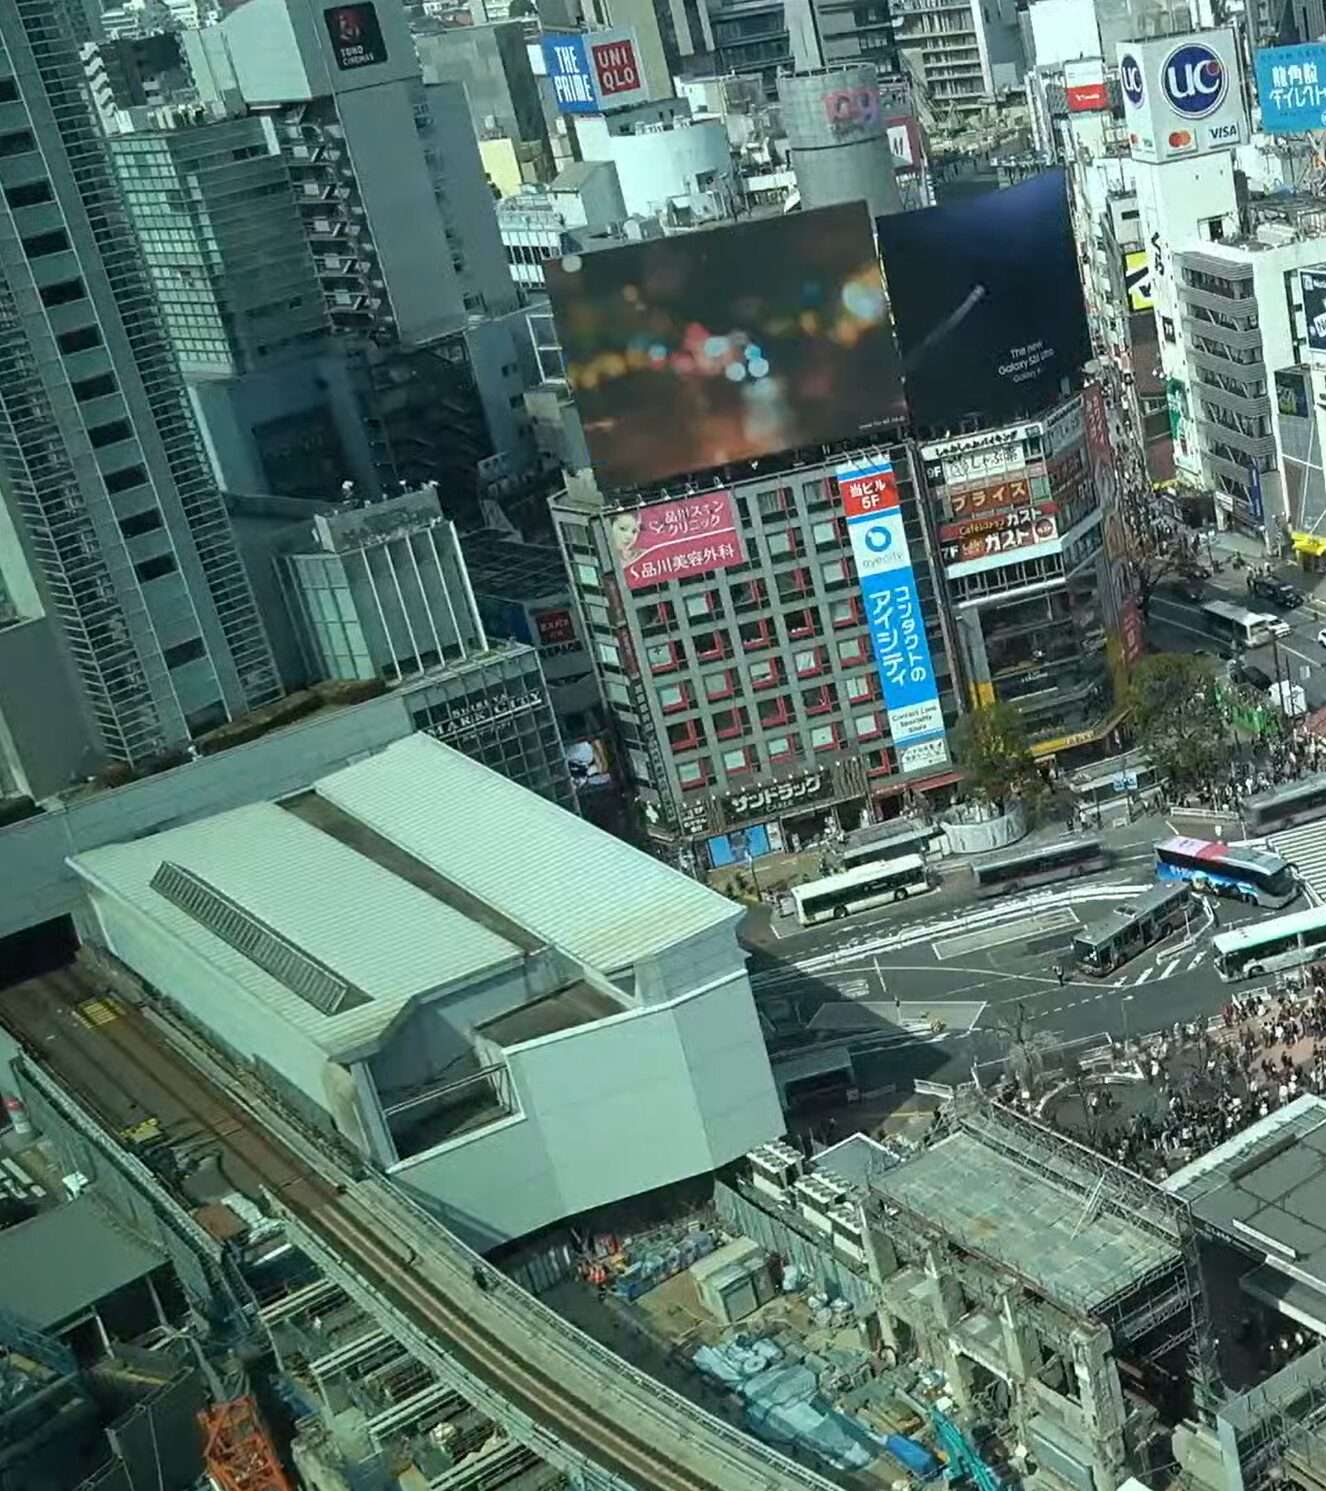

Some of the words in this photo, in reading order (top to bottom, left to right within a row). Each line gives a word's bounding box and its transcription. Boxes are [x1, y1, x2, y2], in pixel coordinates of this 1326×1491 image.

[555, 46, 580, 74] THE
[599, 47, 630, 69] UNI
[555, 74, 594, 103] PRIME
[603, 70, 636, 92] QLO
[1122, 66, 1143, 93] UC
[1168, 59, 1221, 98] UC
[1209, 124, 1238, 139] VISA
[998, 360, 1028, 376] Galaxy
[927, 467, 941, 479] 9F
[1006, 508, 1042, 526] ガスト
[984, 529, 1029, 552] ガスト
[642, 543, 735, 578] 品川美容外科
[941, 547, 959, 561] 7F
[869, 590, 907, 687] アイシティ
[895, 586, 927, 682] コンタクトの
[731, 774, 821, 813] サンドラッグ
